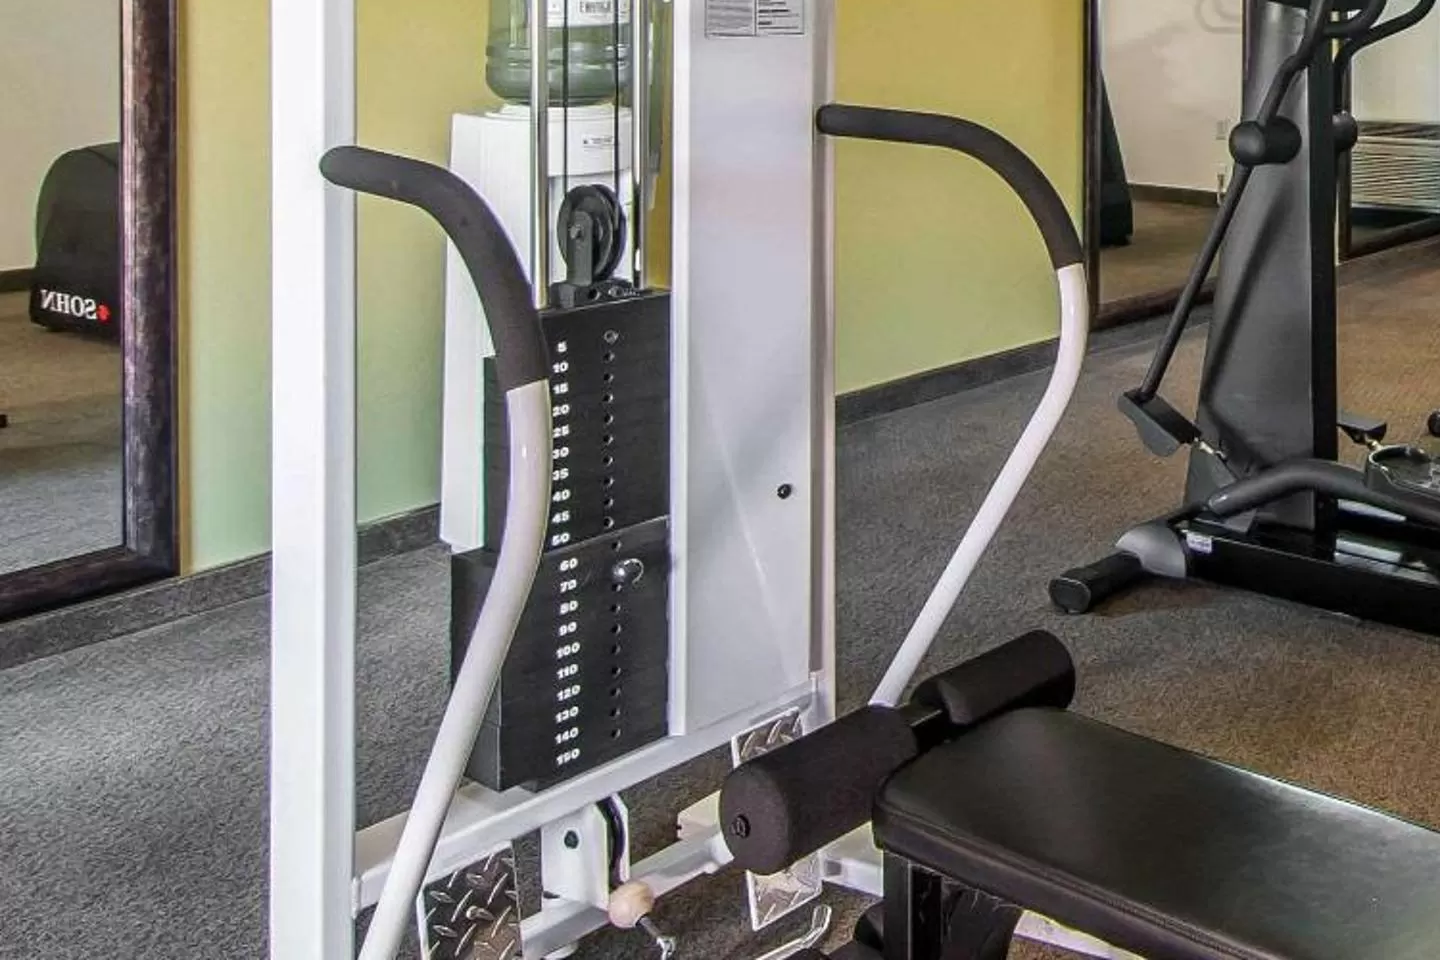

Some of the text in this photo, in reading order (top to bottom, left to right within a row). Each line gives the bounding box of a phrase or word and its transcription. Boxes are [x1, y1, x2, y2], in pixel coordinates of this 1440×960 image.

[557, 341, 567, 353] 5
[552, 361, 569, 373] 10
[553, 382, 569, 394] 15
[552, 404, 570, 417] 20
[552, 424, 570, 438] 25
[552, 446, 570, 459] 30
[552, 468, 569, 481] 35
[552, 489, 571, 502] 40
[552, 510, 570, 524] 45
[559, 557, 579, 572] 60
[560, 579, 577, 593] 70
[559, 600, 579, 615] 80
[559, 621, 577, 637] 90
[556, 642, 581, 659] 100
[556, 663, 579, 680] 110
[557, 684, 581, 701] 120
[555, 706, 579, 723] 130
[555, 727, 579, 744] 140
